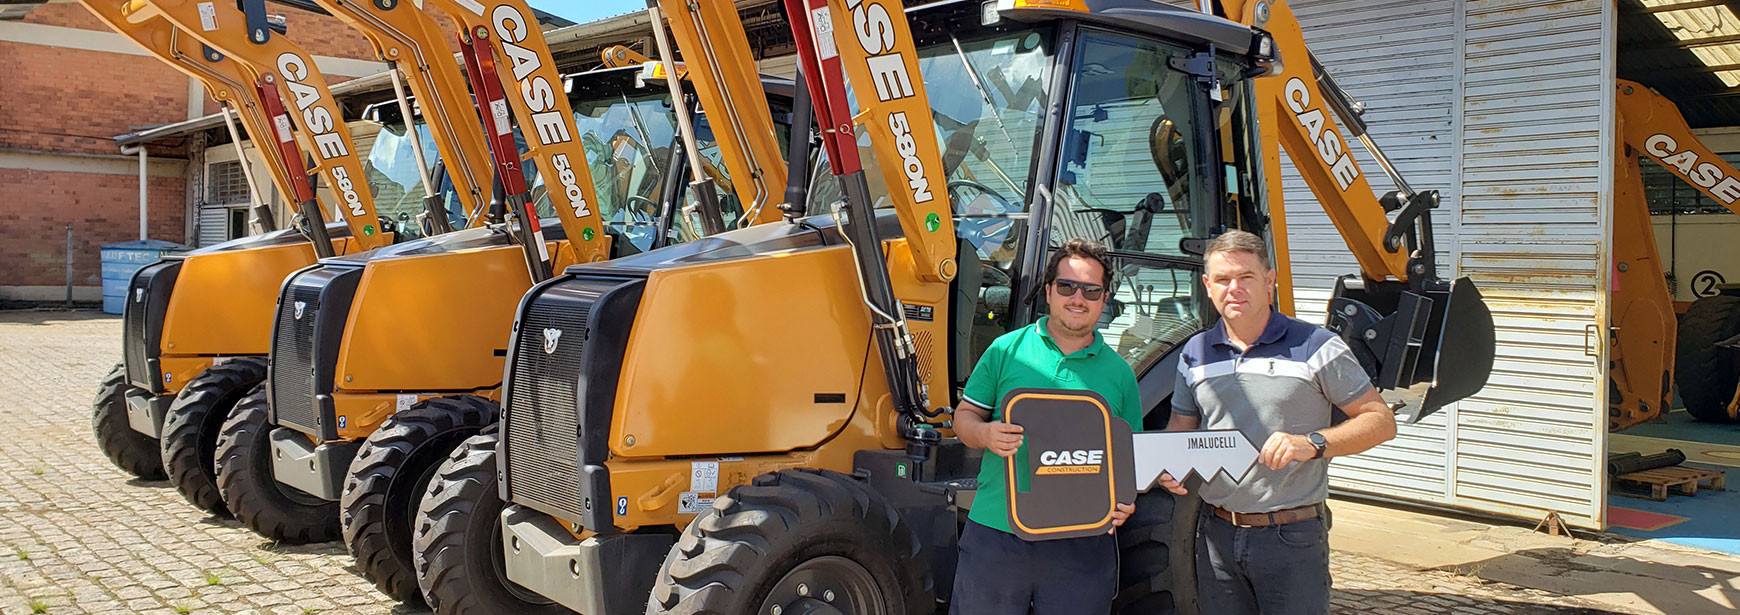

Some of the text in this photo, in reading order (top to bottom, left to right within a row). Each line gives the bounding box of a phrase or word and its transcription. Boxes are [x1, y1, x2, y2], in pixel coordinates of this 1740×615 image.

[276, 52, 366, 217] CASE 580N
[491, 4, 591, 218] CASE 580N
[846, 0, 934, 204] SE 580N
[1285, 77, 1360, 192] CASE
[1644, 133, 1740, 204] CASE
[1701, 276, 1715, 295] 2
[1040, 450, 1104, 466] CASE
